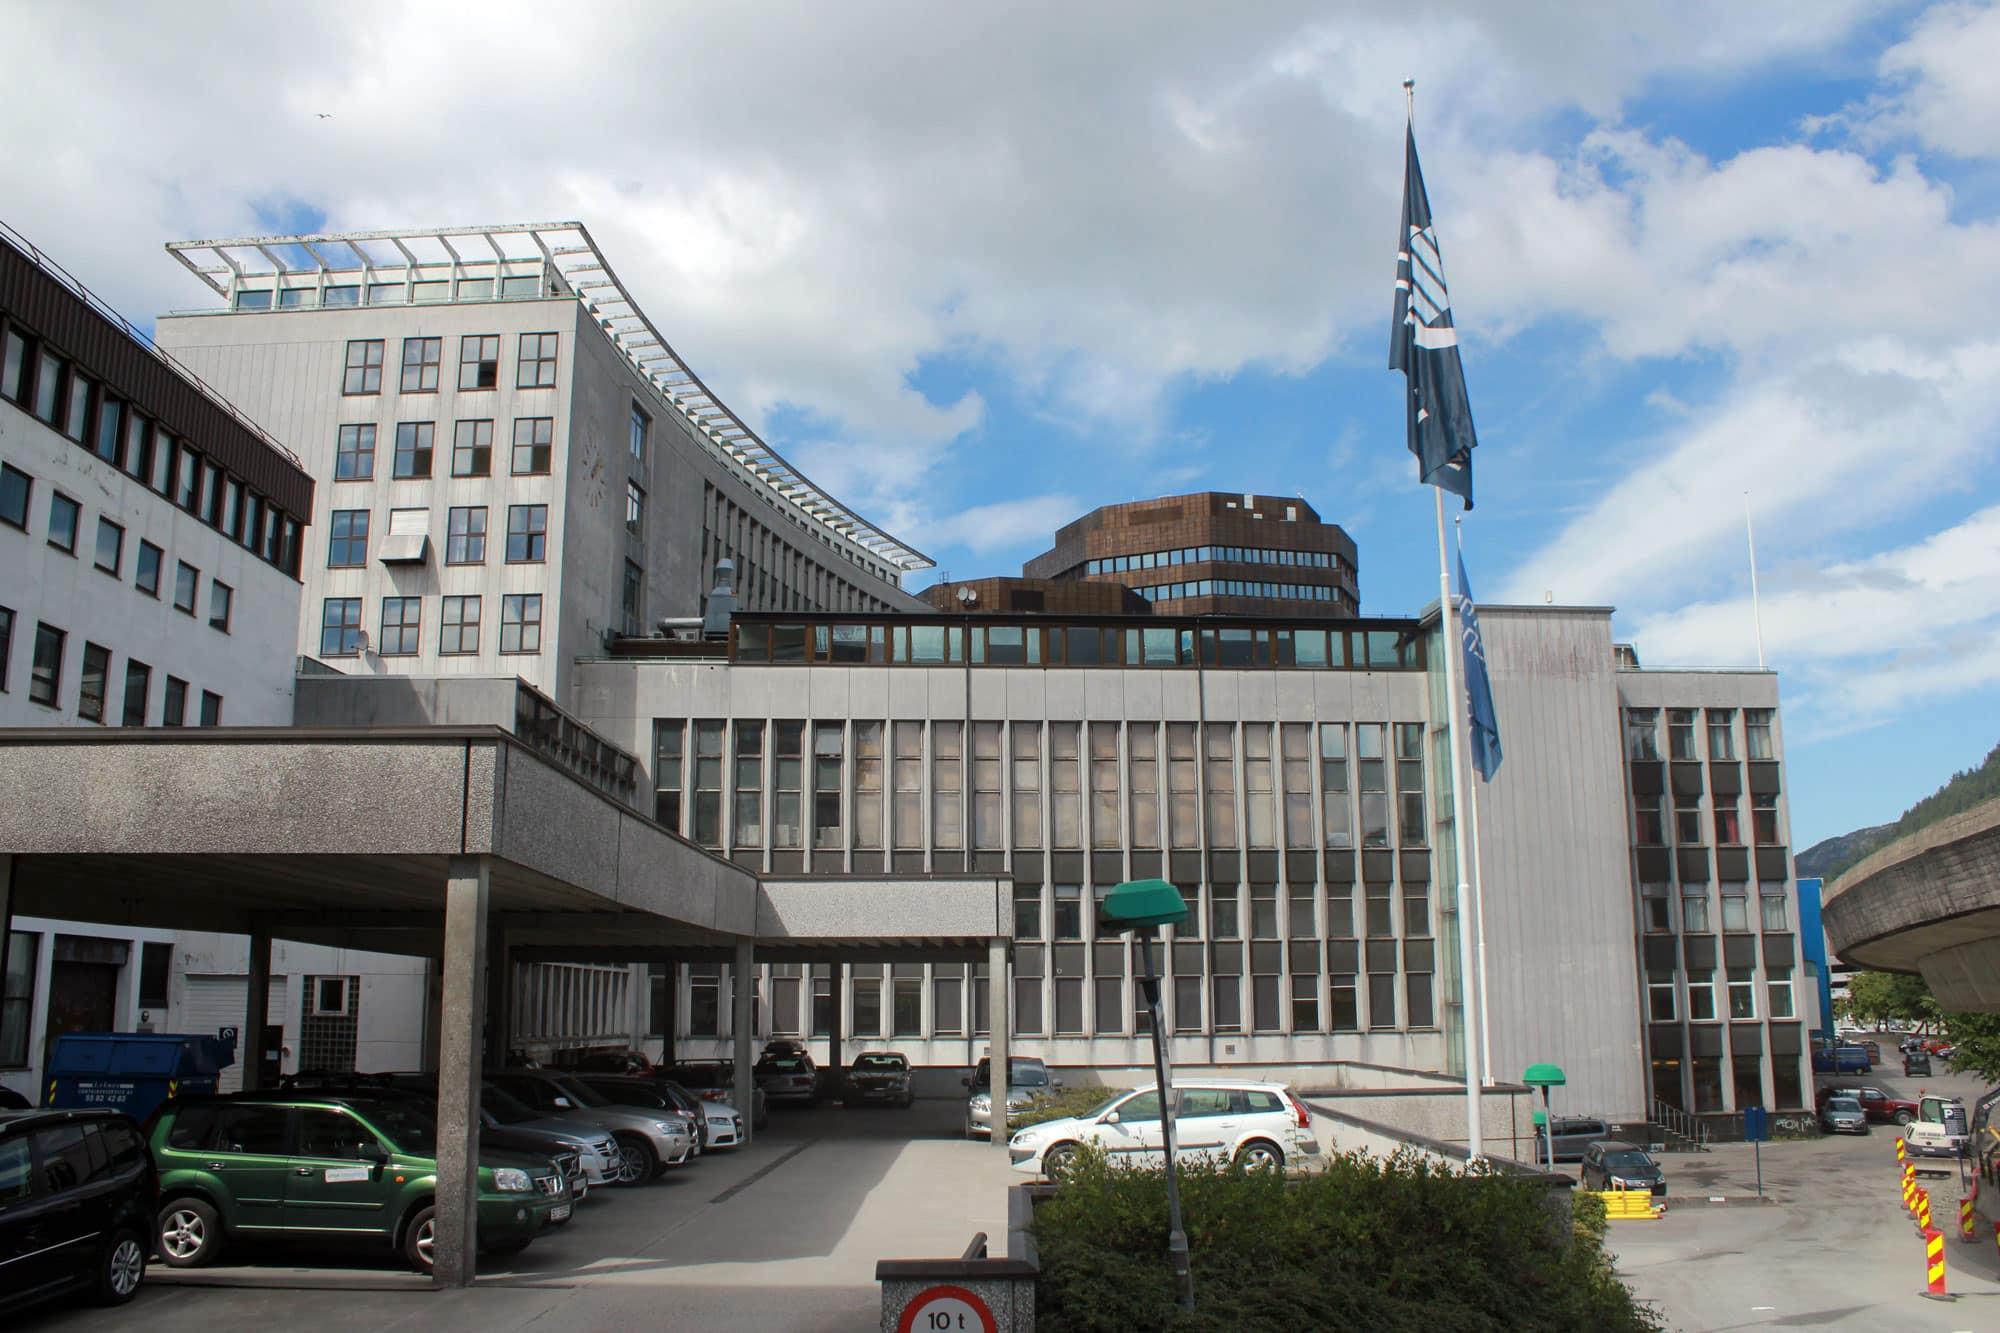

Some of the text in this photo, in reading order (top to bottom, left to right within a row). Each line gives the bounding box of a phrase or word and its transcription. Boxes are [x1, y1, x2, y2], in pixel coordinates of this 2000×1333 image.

[1943, 1108, 1953, 1119] P
[927, 1312, 965, 1330] 10 t
